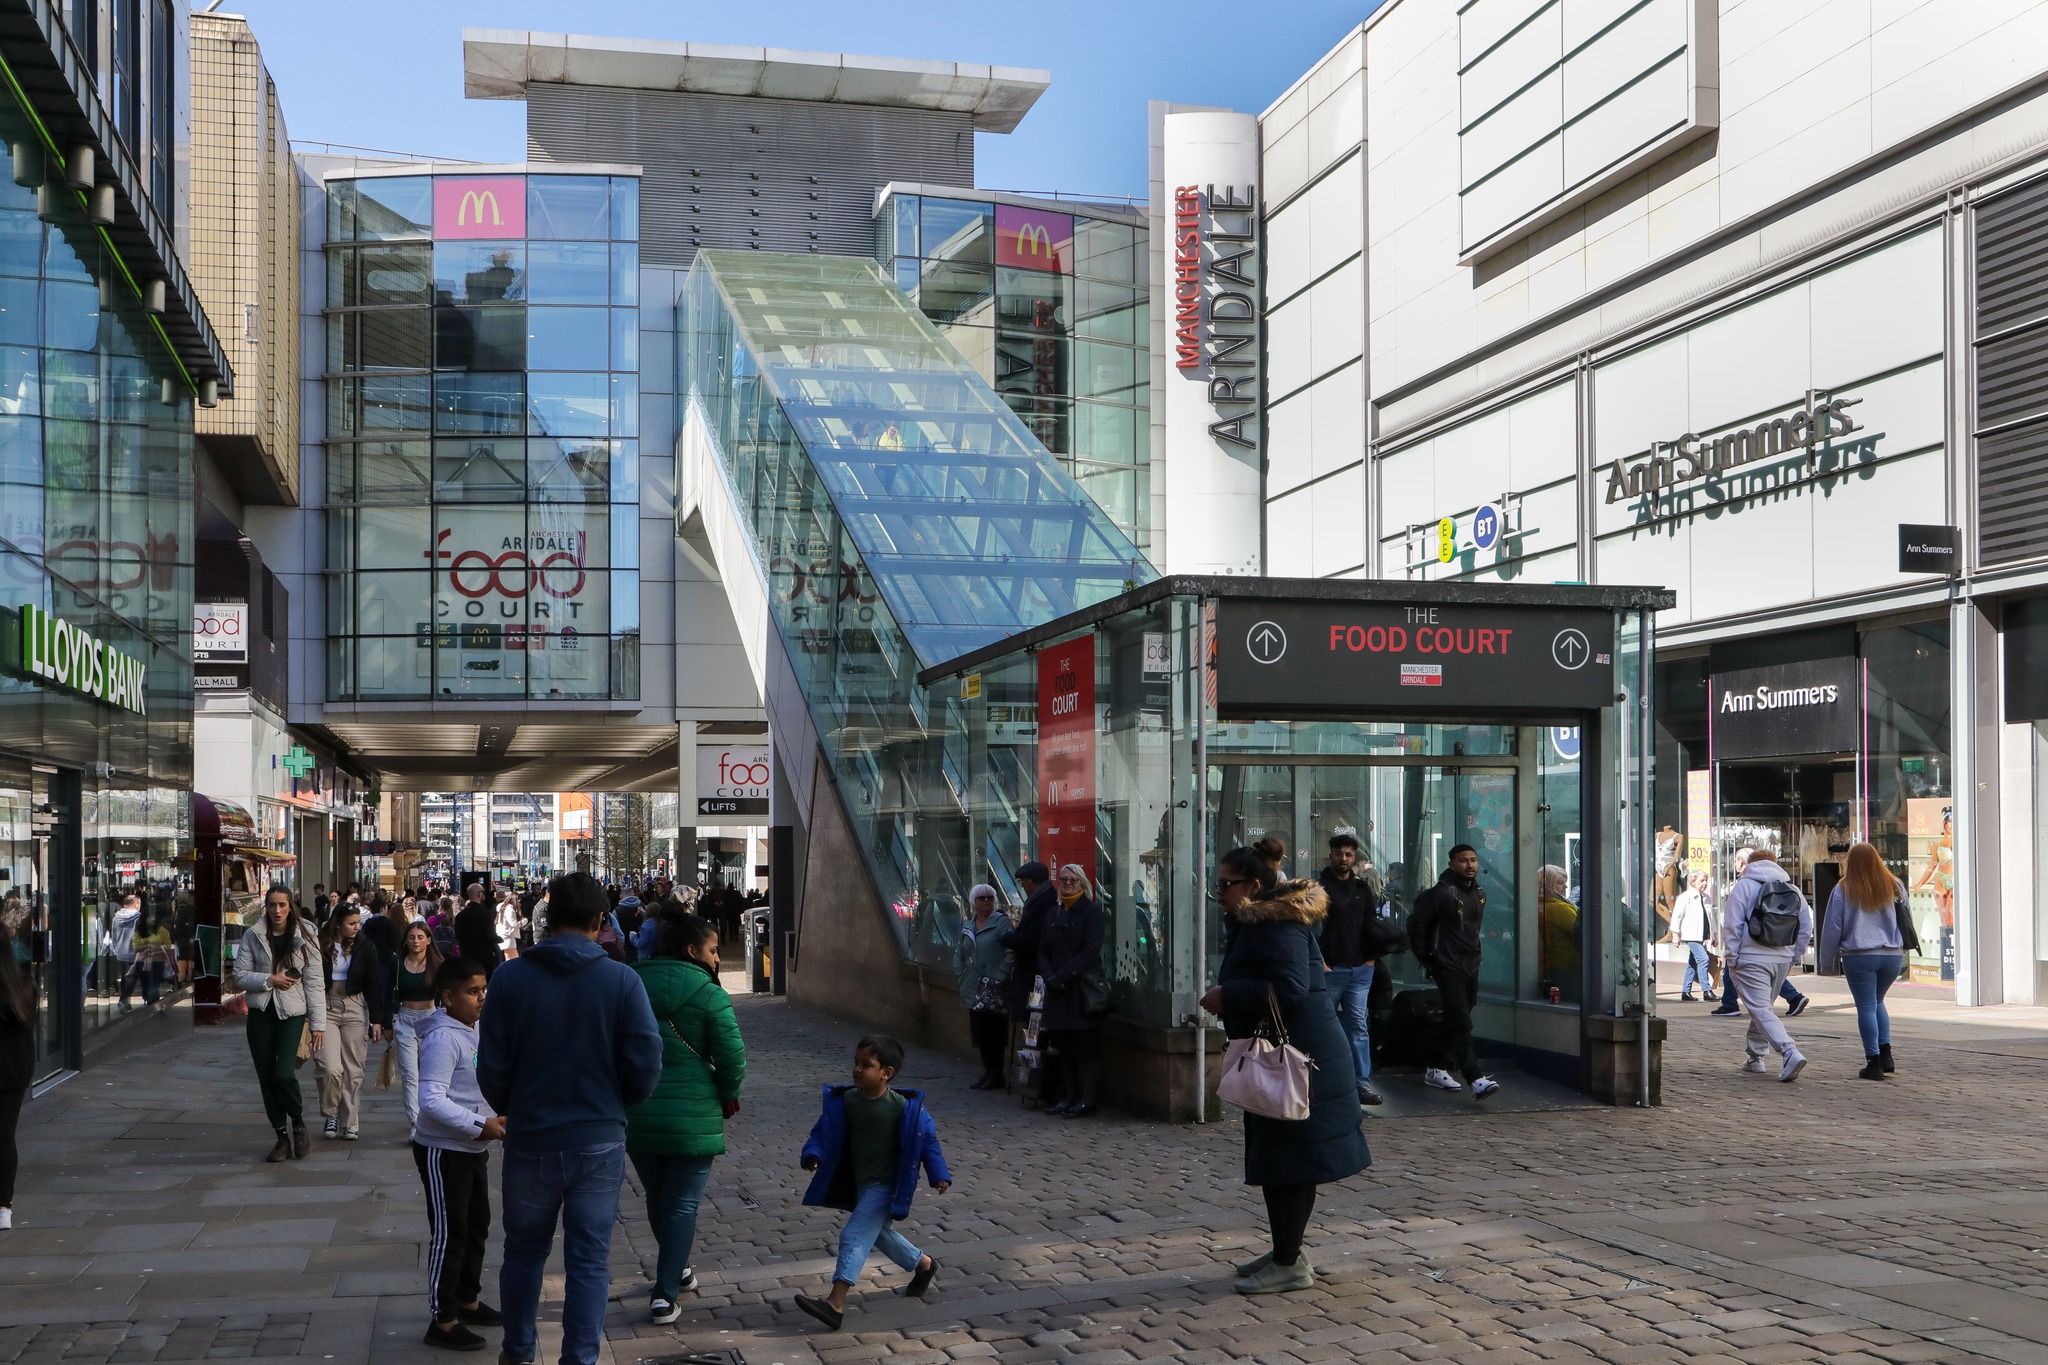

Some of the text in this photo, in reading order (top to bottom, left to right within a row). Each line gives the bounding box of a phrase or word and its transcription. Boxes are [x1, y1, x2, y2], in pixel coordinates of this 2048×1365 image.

[1174, 184, 1199, 369] MANCHESTER
[1207, 183, 1257, 449] ARNDALE
[1605, 398, 1855, 504] Ann Summers
[1477, 516, 1494, 538] BT
[1906, 543, 1954, 554] Ann Summers
[1403, 606, 1440, 625] THE
[508, 631, 542, 643] KC
[1330, 625, 1512, 655] FOOD COURT
[25, 603, 146, 716] LLOYDS BANK
[1060, 657, 1071, 672] THE
[1402, 665, 1439, 674] MANCHESTER
[212, 678, 236, 686] MALL
[1055, 671, 1076, 695] FOOD
[1402, 675, 1427, 684] ARNDALE
[1052, 691, 1079, 716] COURT
[1720, 684, 1839, 713] Ann Summers
[718, 752, 769, 785] foo
[711, 803, 737, 811] LIFTS
[1915, 814, 1925, 826] 24
